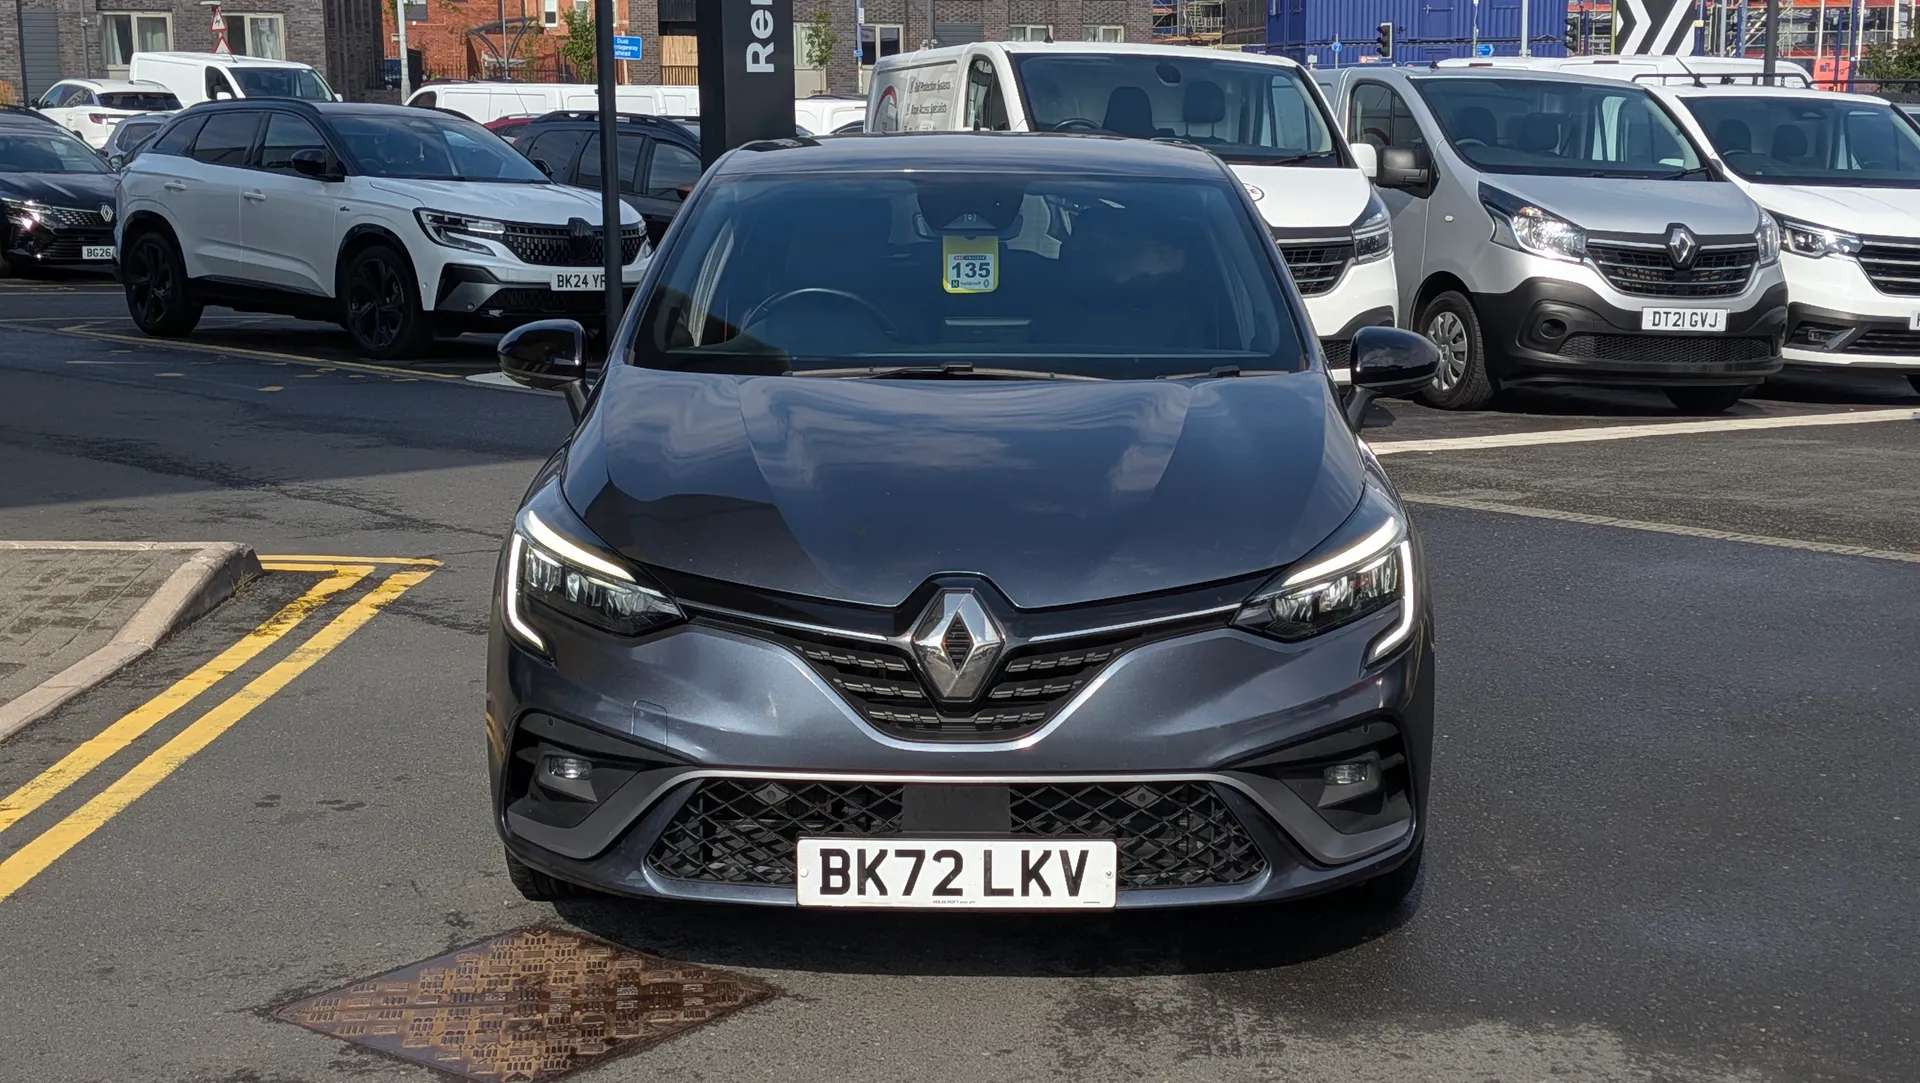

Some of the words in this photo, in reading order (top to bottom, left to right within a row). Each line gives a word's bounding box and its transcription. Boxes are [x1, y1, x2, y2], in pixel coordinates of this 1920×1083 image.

[746, 0, 775, 73] Re
[86, 248, 112, 258] BG26
[952, 262, 990, 278] 135
[557, 274, 589, 288] BK24
[1652, 311, 1686, 327] DT21
[1690, 312, 1718, 328] GVJ
[819, 848, 963, 897] BK72
[983, 849, 1089, 897] LKV
